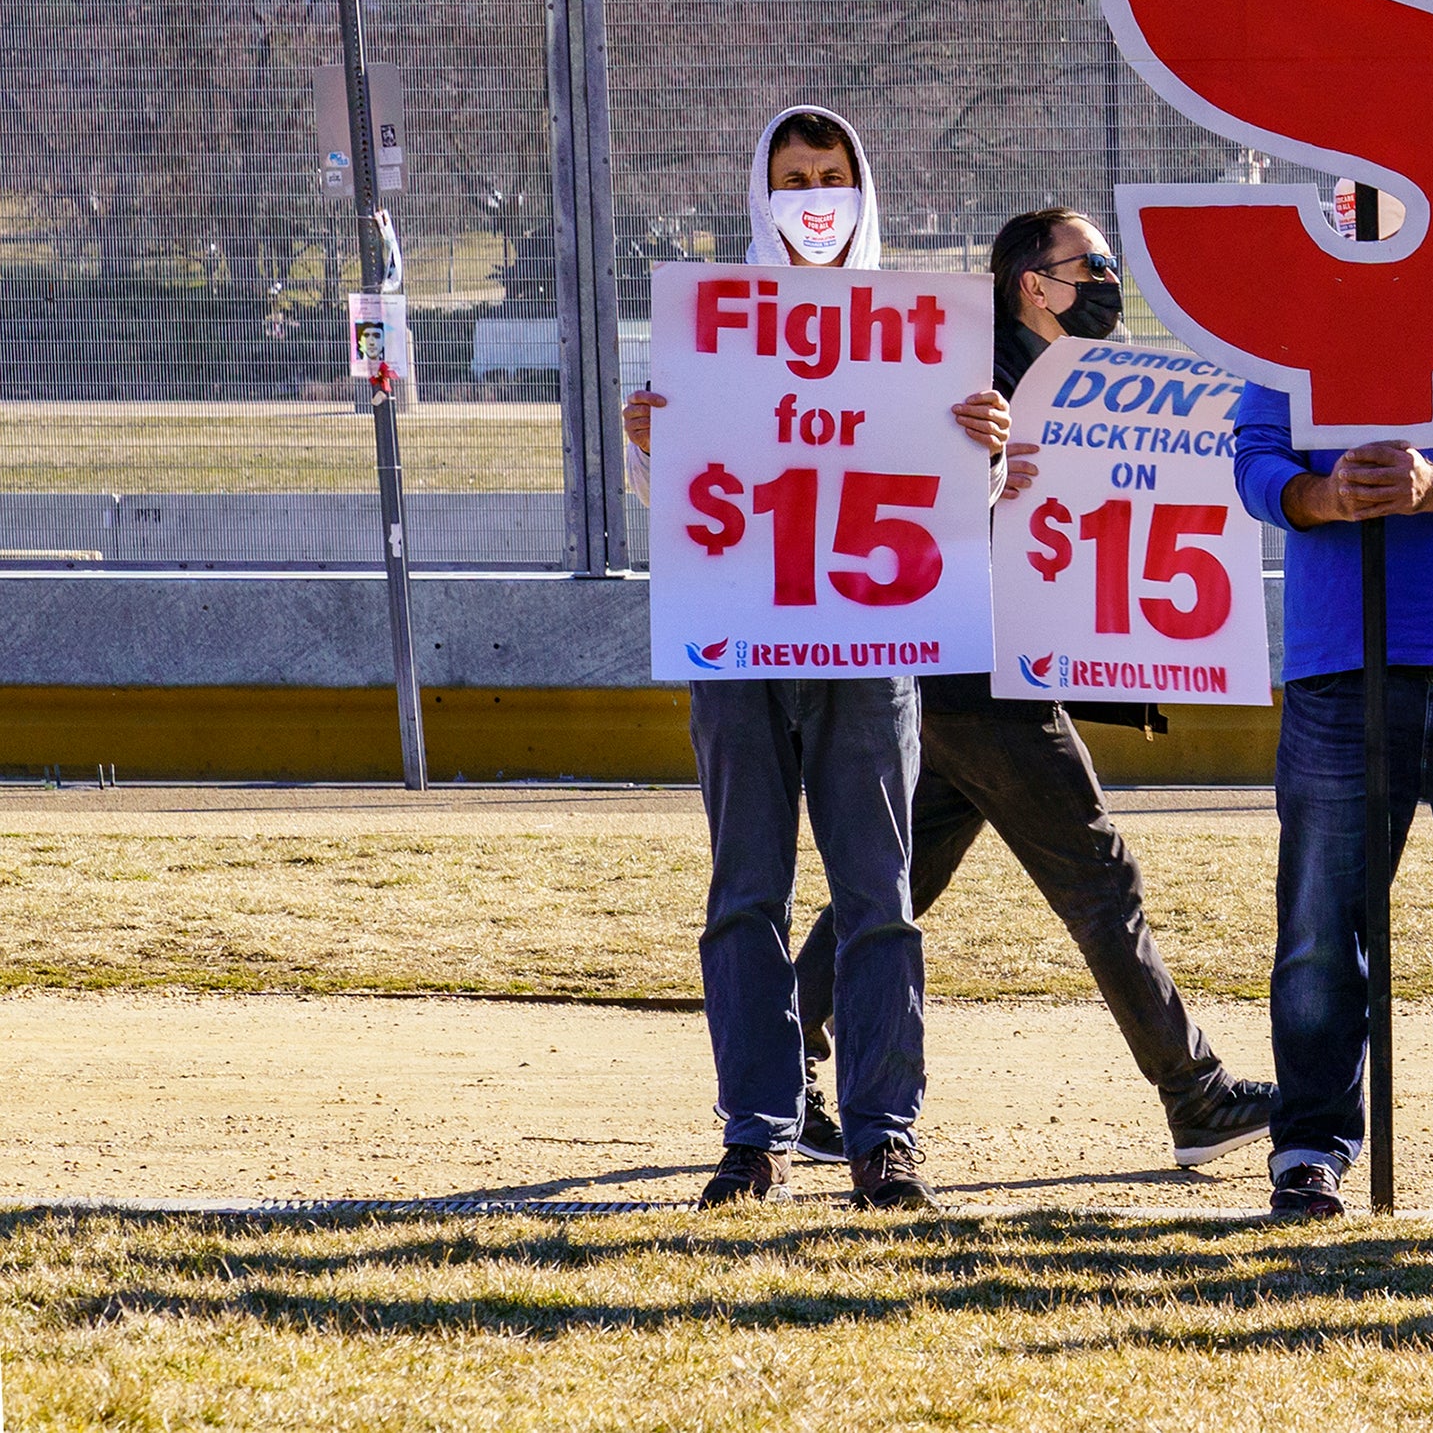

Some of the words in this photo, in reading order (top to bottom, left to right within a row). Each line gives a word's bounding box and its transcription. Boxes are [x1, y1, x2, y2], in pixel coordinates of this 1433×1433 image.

[696, 279, 946, 379] Fight
[775, 394, 865, 446] for
[1041, 420, 1235, 458] BACKTRACK
[1111, 462, 1157, 490] ON
[687, 463, 943, 606] $15
[1026, 497, 1232, 640] $15
[735, 639, 748, 668] OUR
[752, 640, 939, 668] REVOLUTION
[1058, 654, 1070, 688] OUR
[1071, 661, 1227, 693] REVOLUTION
